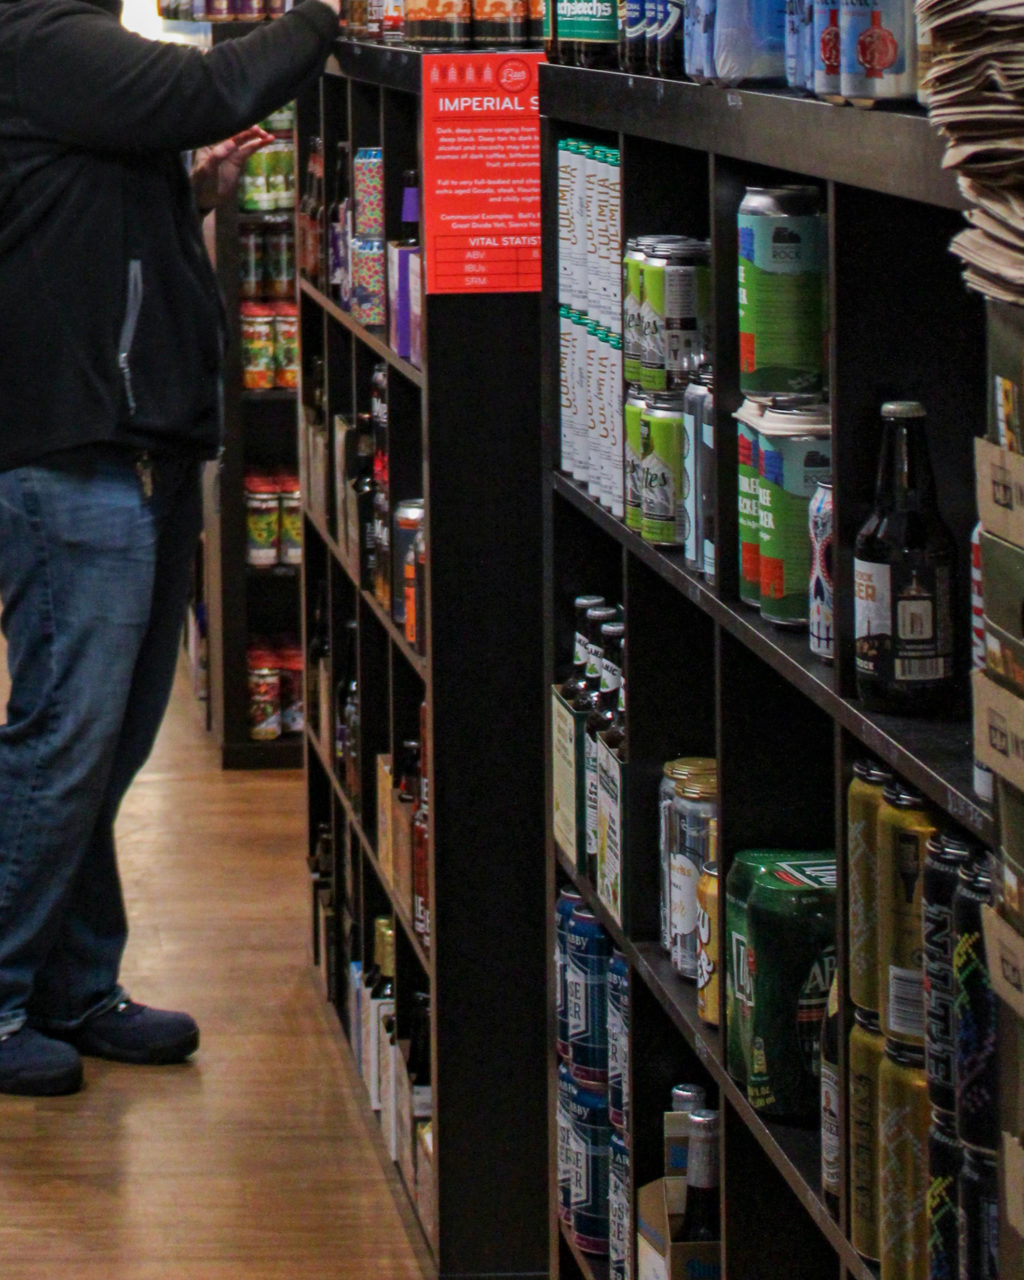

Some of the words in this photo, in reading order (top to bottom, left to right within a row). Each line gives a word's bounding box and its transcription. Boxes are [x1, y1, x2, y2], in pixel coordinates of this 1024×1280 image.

[439, 97, 525, 111] IMPERIAL
[469, 237, 499, 246] VITAL
[465, 250, 486, 259] ABV
[464, 277, 487, 286] SRM
